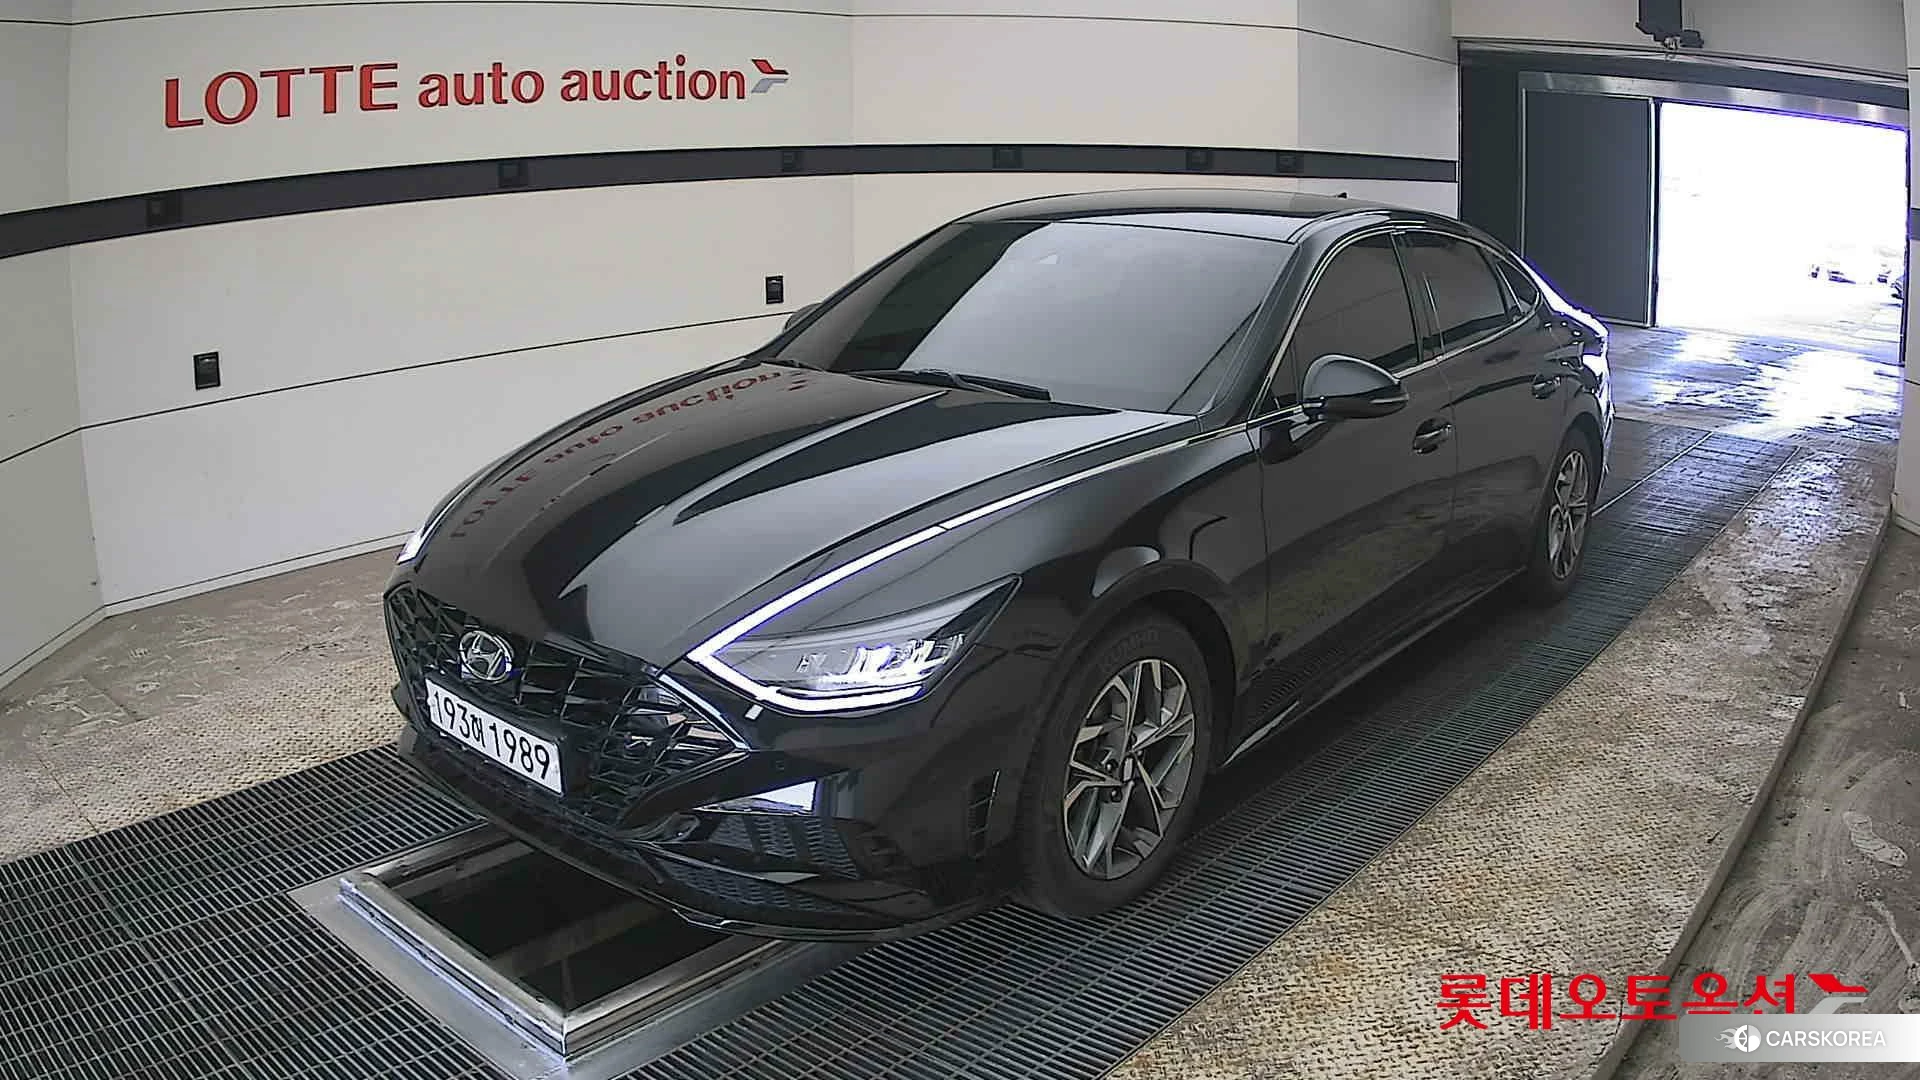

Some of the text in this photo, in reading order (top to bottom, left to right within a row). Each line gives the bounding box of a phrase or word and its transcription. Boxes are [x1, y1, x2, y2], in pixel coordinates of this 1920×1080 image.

[164, 54, 746, 129] LOTTE auto auction
